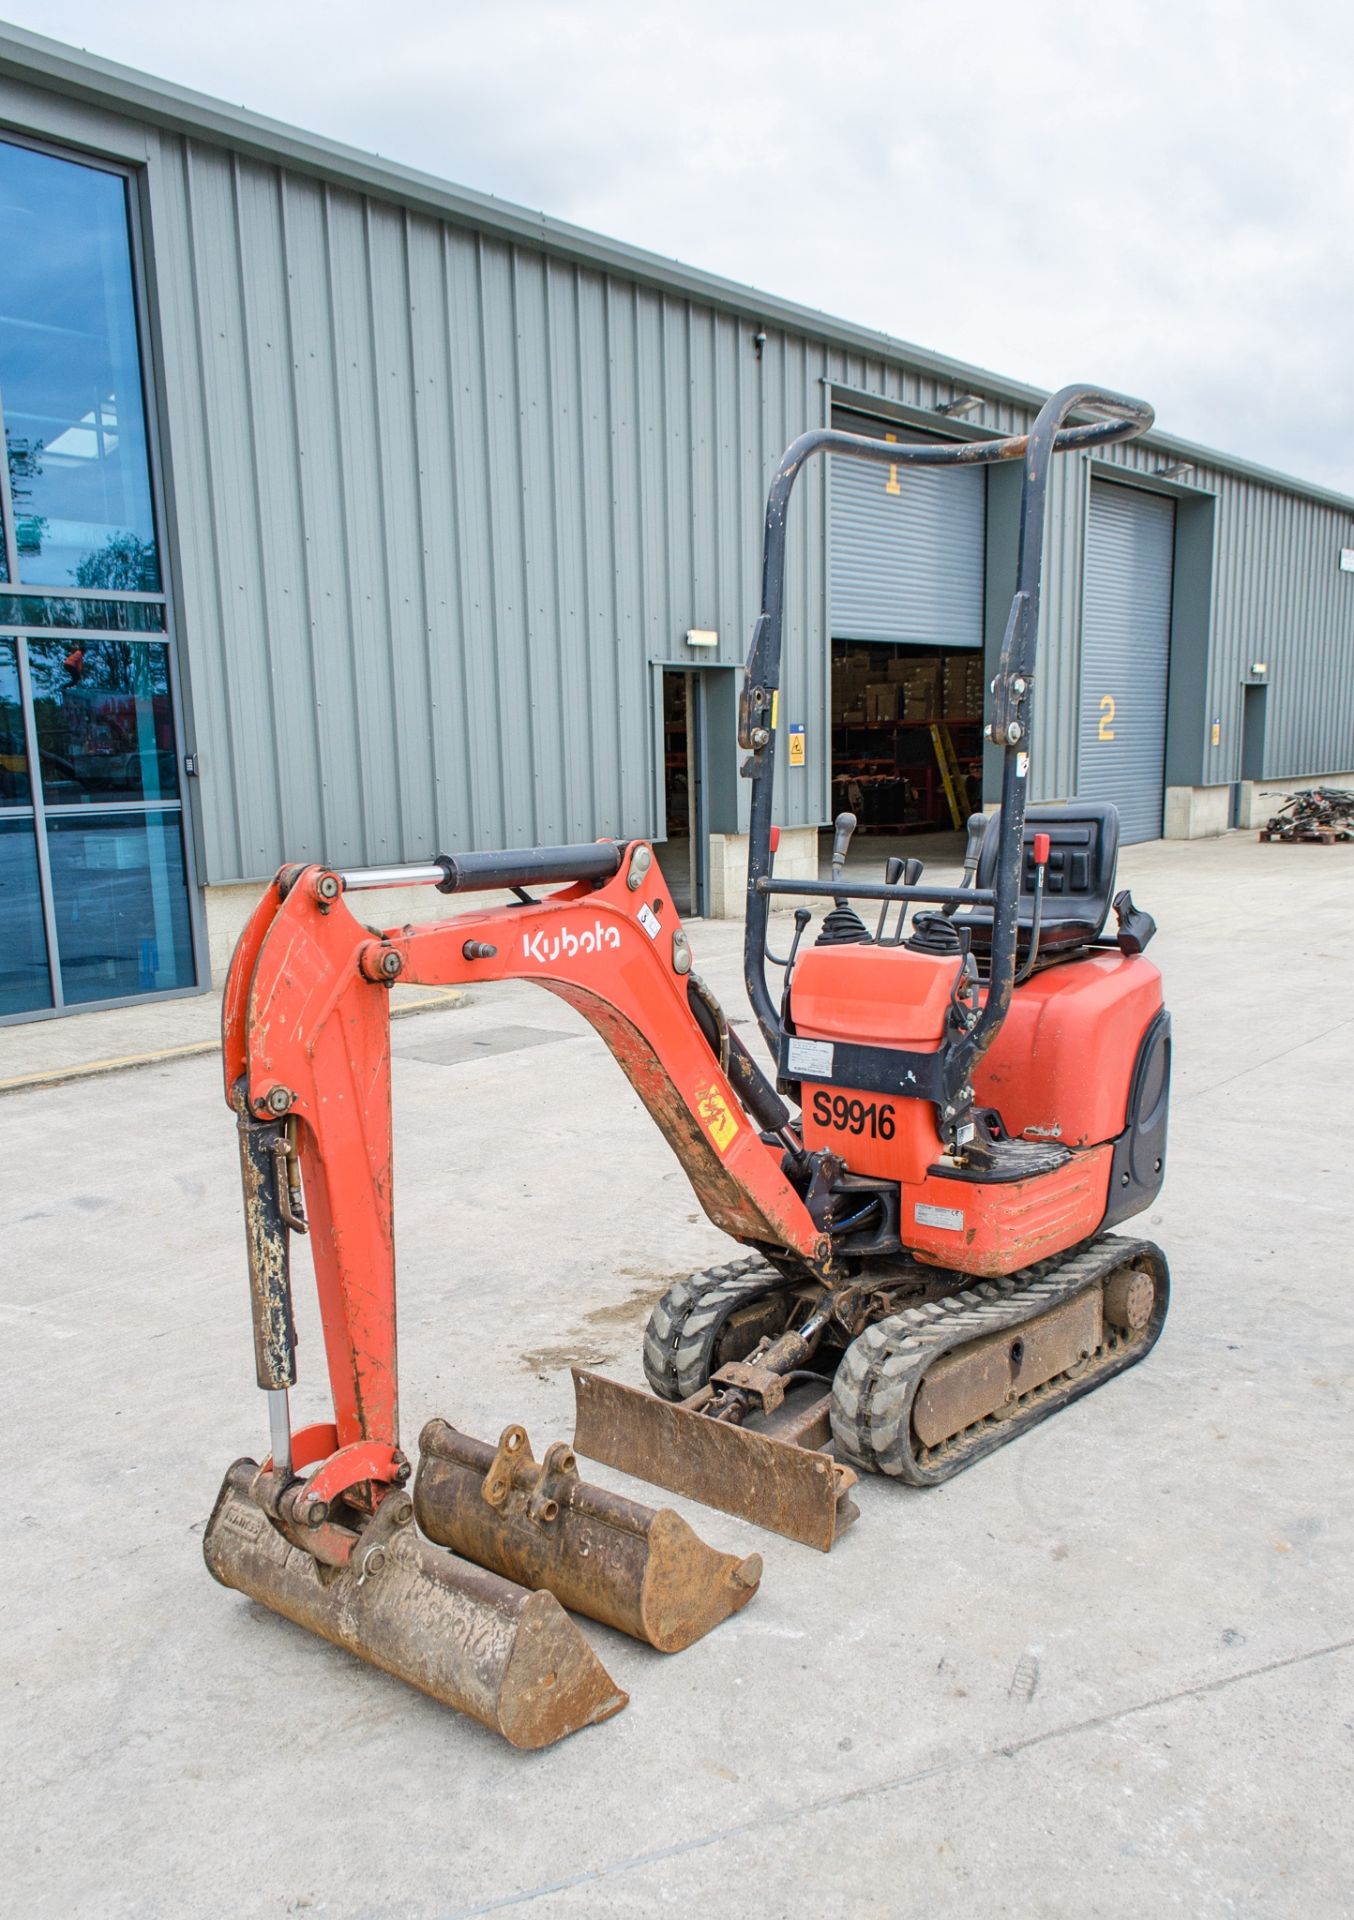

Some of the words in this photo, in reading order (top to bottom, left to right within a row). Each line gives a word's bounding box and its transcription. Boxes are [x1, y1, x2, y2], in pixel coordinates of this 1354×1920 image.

[885, 432, 901, 495] 1
[1098, 695, 1116, 741] 2
[522, 920, 621, 963] Kubota
[812, 1090, 896, 1141] S9916
